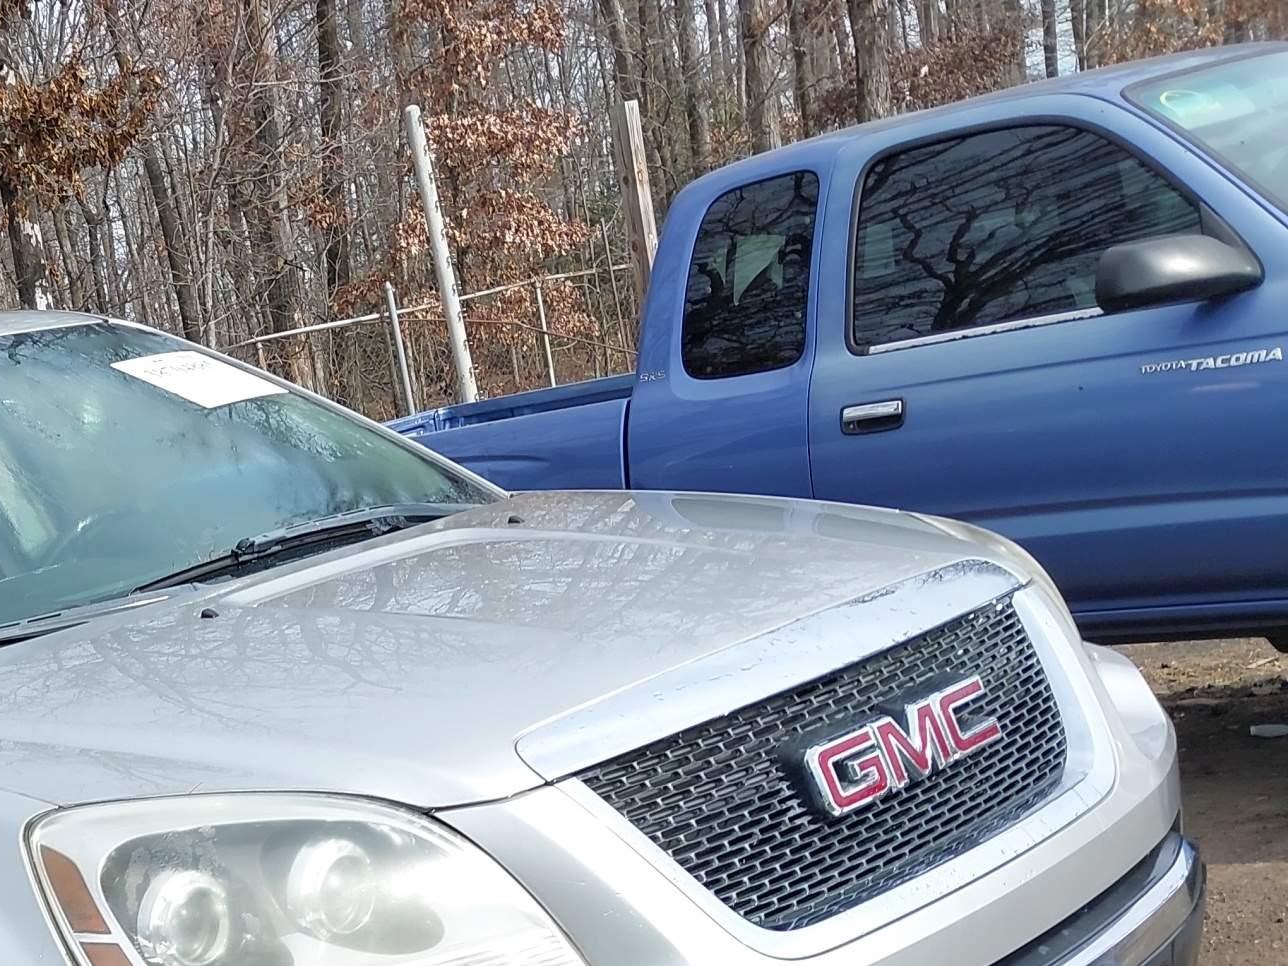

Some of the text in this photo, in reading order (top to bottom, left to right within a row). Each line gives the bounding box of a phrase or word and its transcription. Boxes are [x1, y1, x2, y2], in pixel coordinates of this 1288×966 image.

[1140, 347, 1283, 374] TOYOTA TACOMA
[804, 674, 1003, 816] GMC
